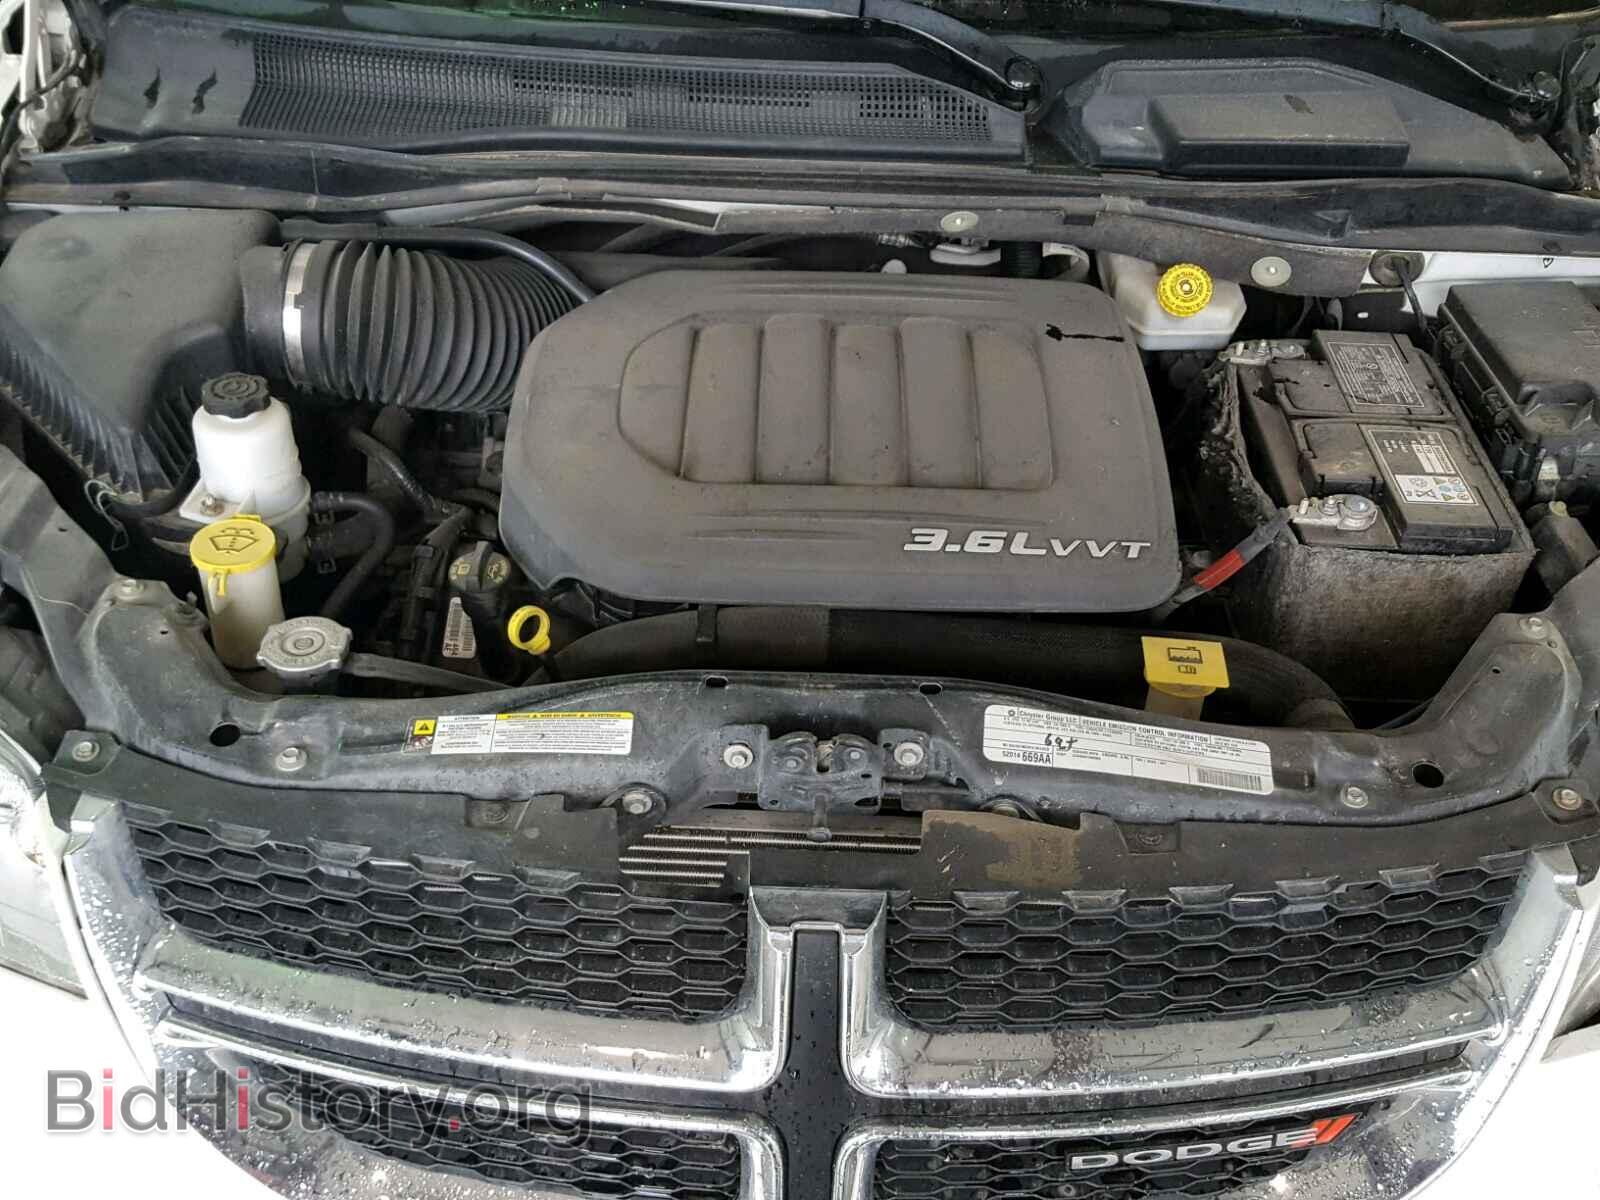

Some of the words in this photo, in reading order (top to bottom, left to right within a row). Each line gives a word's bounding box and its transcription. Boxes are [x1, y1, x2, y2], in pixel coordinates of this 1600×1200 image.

[903, 528, 1047, 556] 3.6L
[1050, 538, 1151, 559] VVT
[1020, 710, 1044, 720] Chrysler
[1046, 713, 1065, 723] Group
[1066, 715, 1077, 723] LLC
[1083, 719, 1107, 728] VEHICLE
[1108, 722, 1137, 732] EMISSION
[1139, 727, 1166, 737] CONTROL
[1168, 731, 1209, 743] INFORMATION
[1022, 752, 1052, 765] 669AA
[1070, 1127, 1318, 1170] DODGE
